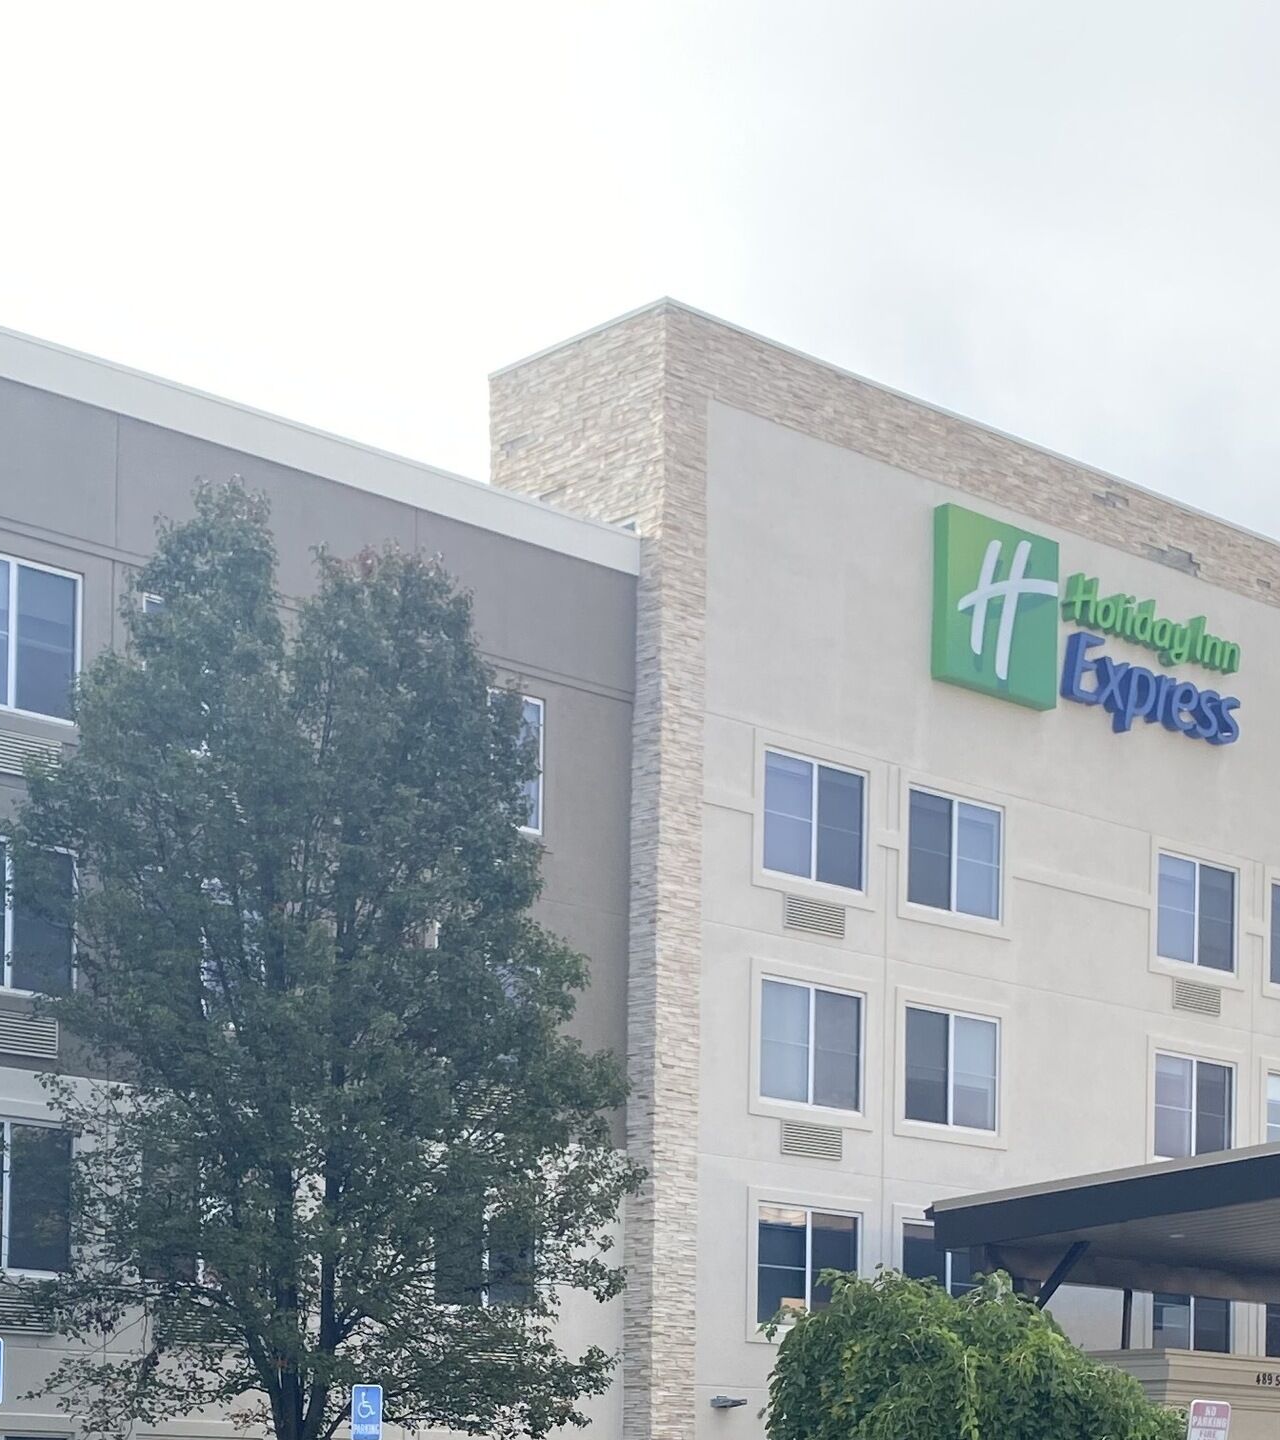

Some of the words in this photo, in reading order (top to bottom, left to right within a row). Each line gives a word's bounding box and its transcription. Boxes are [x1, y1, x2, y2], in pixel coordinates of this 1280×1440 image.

[1061, 573, 1191, 667] Holiday
[1190, 616, 1241, 674] Inn
[1060, 632, 1241, 745] Express
[1192, 1416, 1227, 1428] PARKING
[1205, 1406, 1217, 1416] NO
